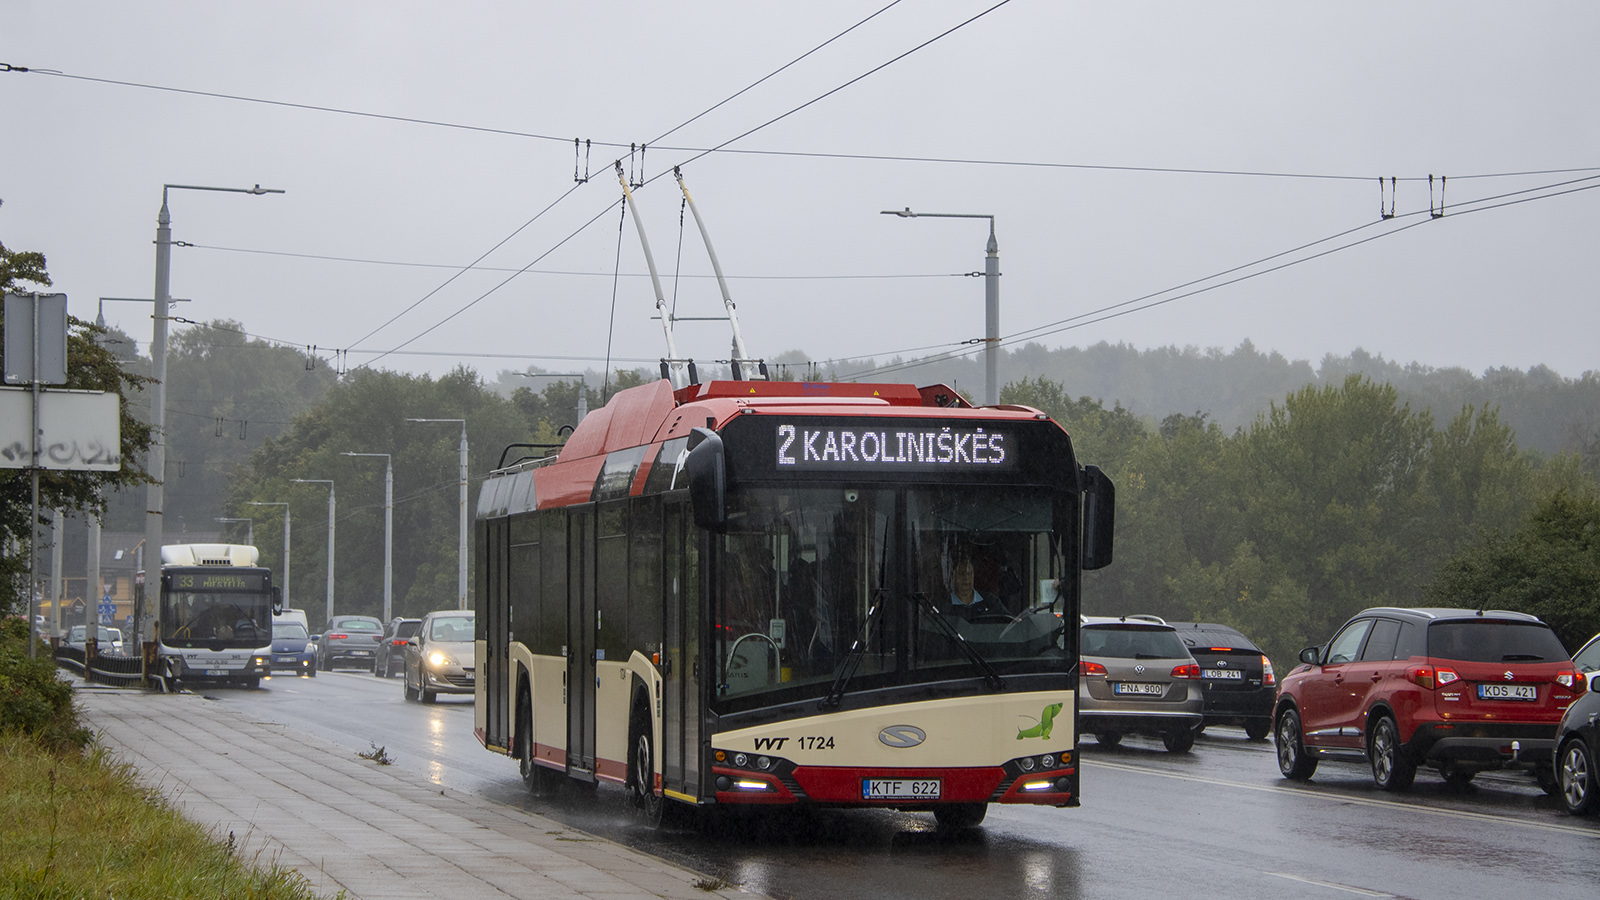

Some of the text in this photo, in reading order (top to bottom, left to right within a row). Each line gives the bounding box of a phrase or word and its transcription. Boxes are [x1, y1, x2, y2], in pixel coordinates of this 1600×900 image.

[778, 424, 1005, 465] 2 KAROLINIŠKĖS
[179, 575, 194, 588] 33
[1226, 670, 1240, 678] 241
[1120, 684, 1161, 693] FNA 900
[1484, 685, 1534, 698] KDS 421
[798, 736, 835, 750] 1724
[872, 782, 902, 795] KTF
[912, 781, 938, 795] 622
